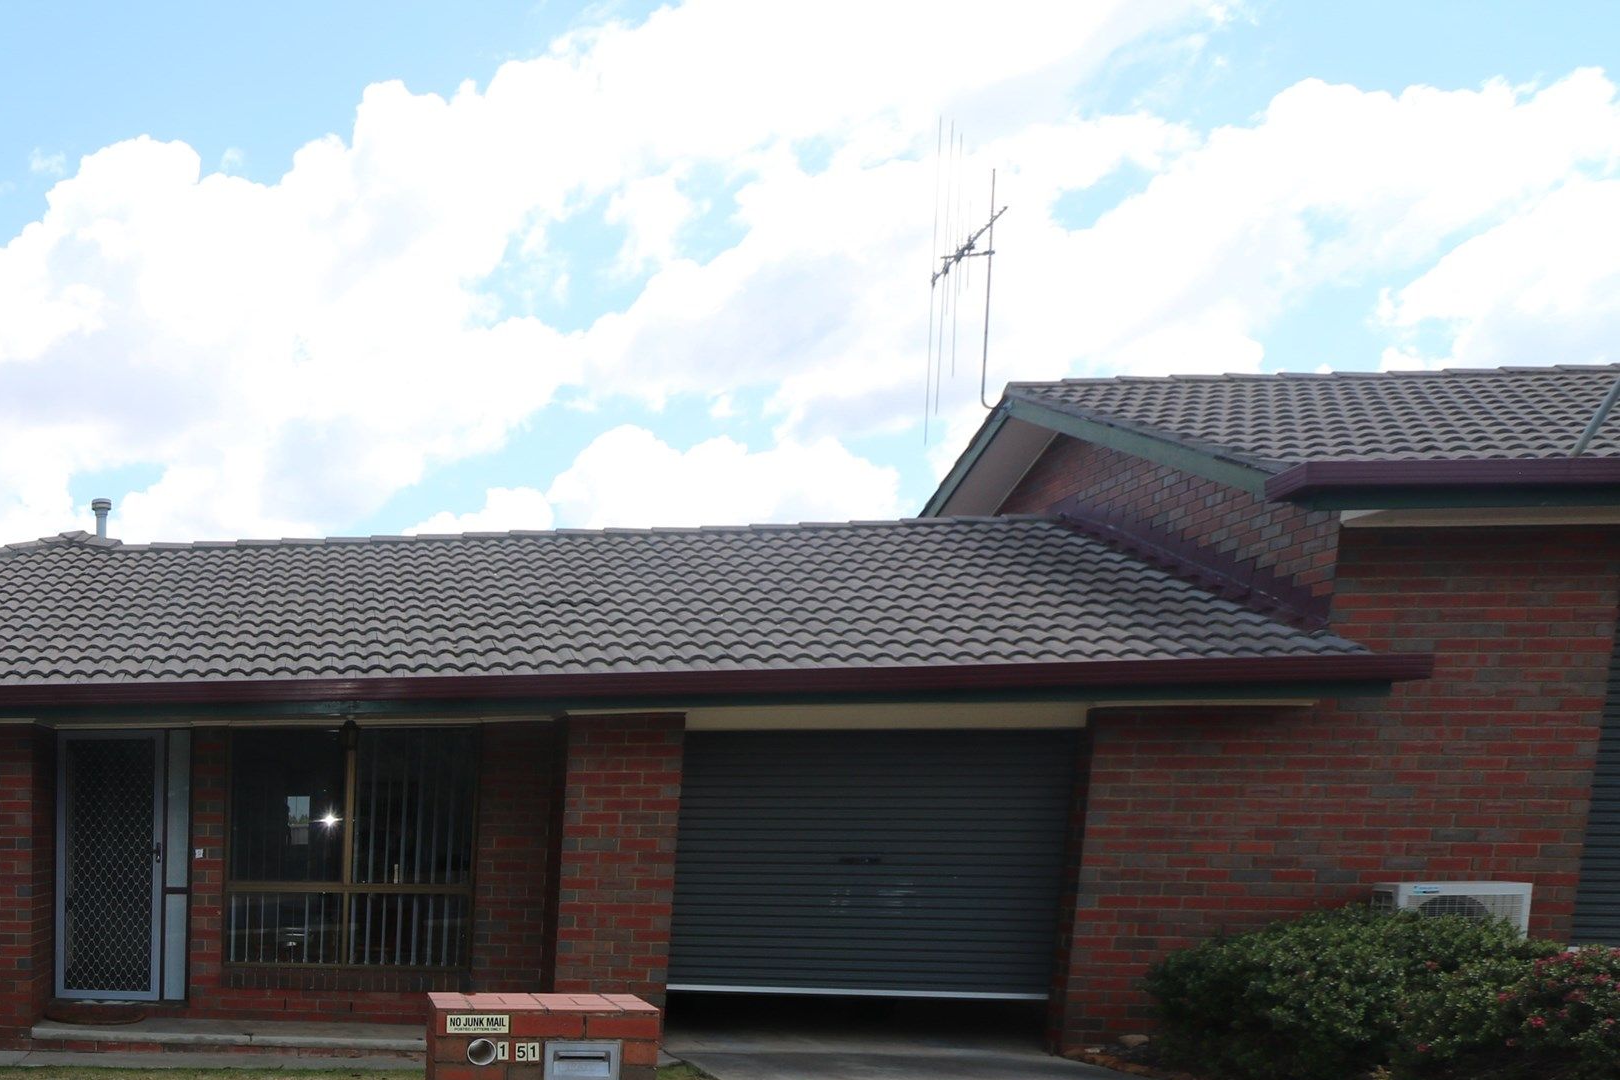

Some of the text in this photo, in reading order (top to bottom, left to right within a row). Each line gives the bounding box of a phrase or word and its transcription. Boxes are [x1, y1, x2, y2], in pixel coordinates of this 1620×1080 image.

[450, 1017, 506, 1027] NO JUNK MAIL
